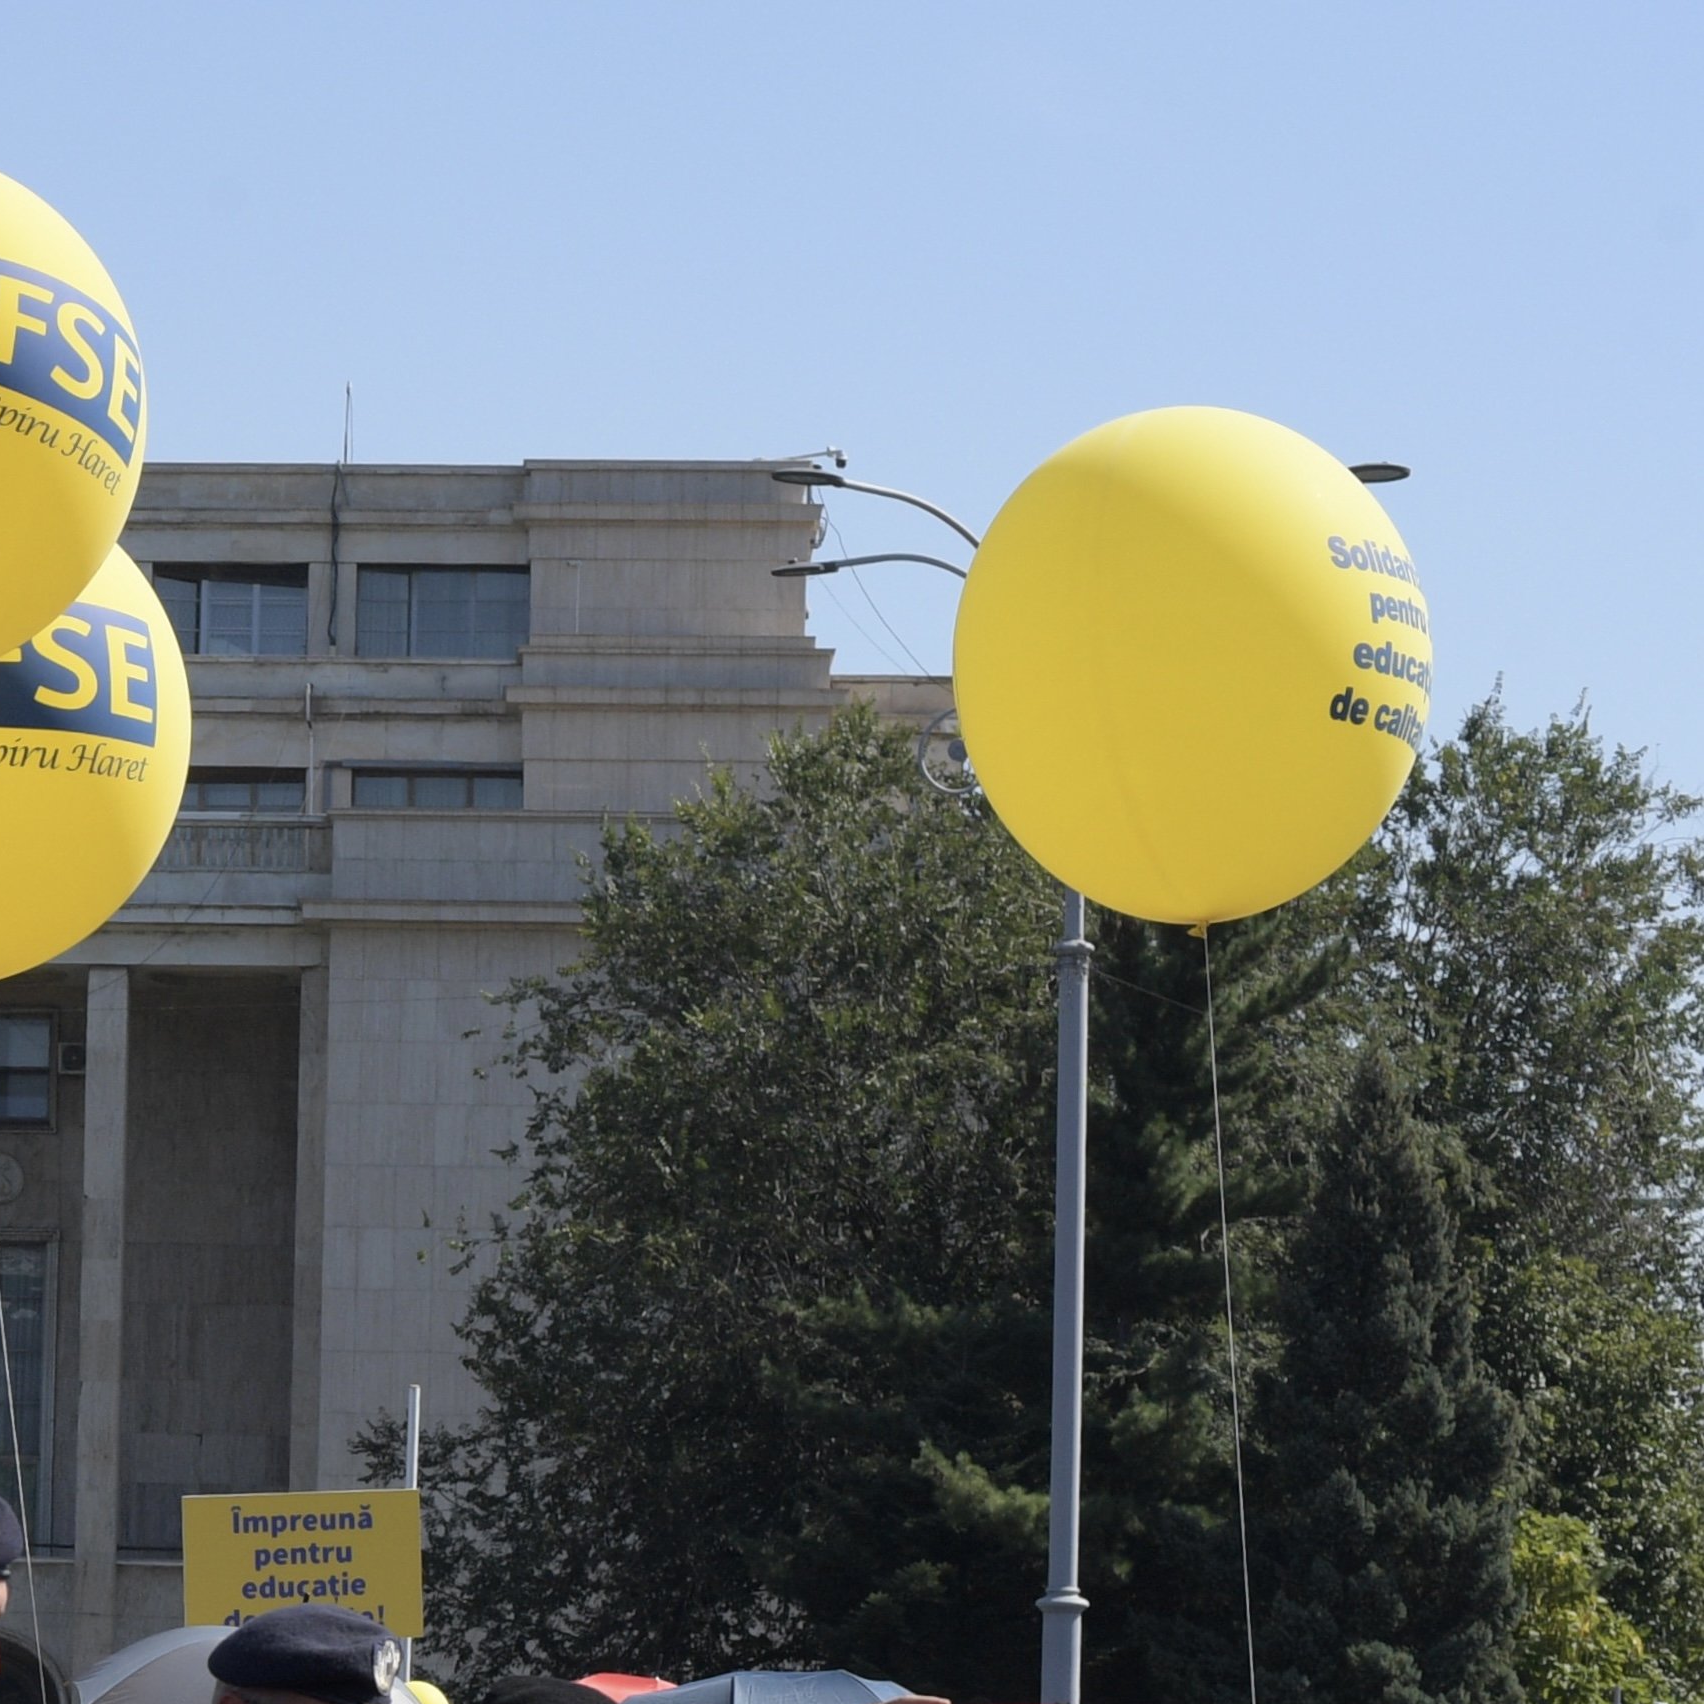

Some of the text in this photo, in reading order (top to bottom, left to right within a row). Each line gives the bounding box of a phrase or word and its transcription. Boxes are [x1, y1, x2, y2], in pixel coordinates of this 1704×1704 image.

[60, 431, 122, 497] Haret
[1329, 686, 1370, 726] de
[65, 742, 150, 783] Haret
[231, 1504, 374, 1538] Împreună
[254, 1542, 353, 1571] pentru
[241, 1571, 367, 1604] educație
